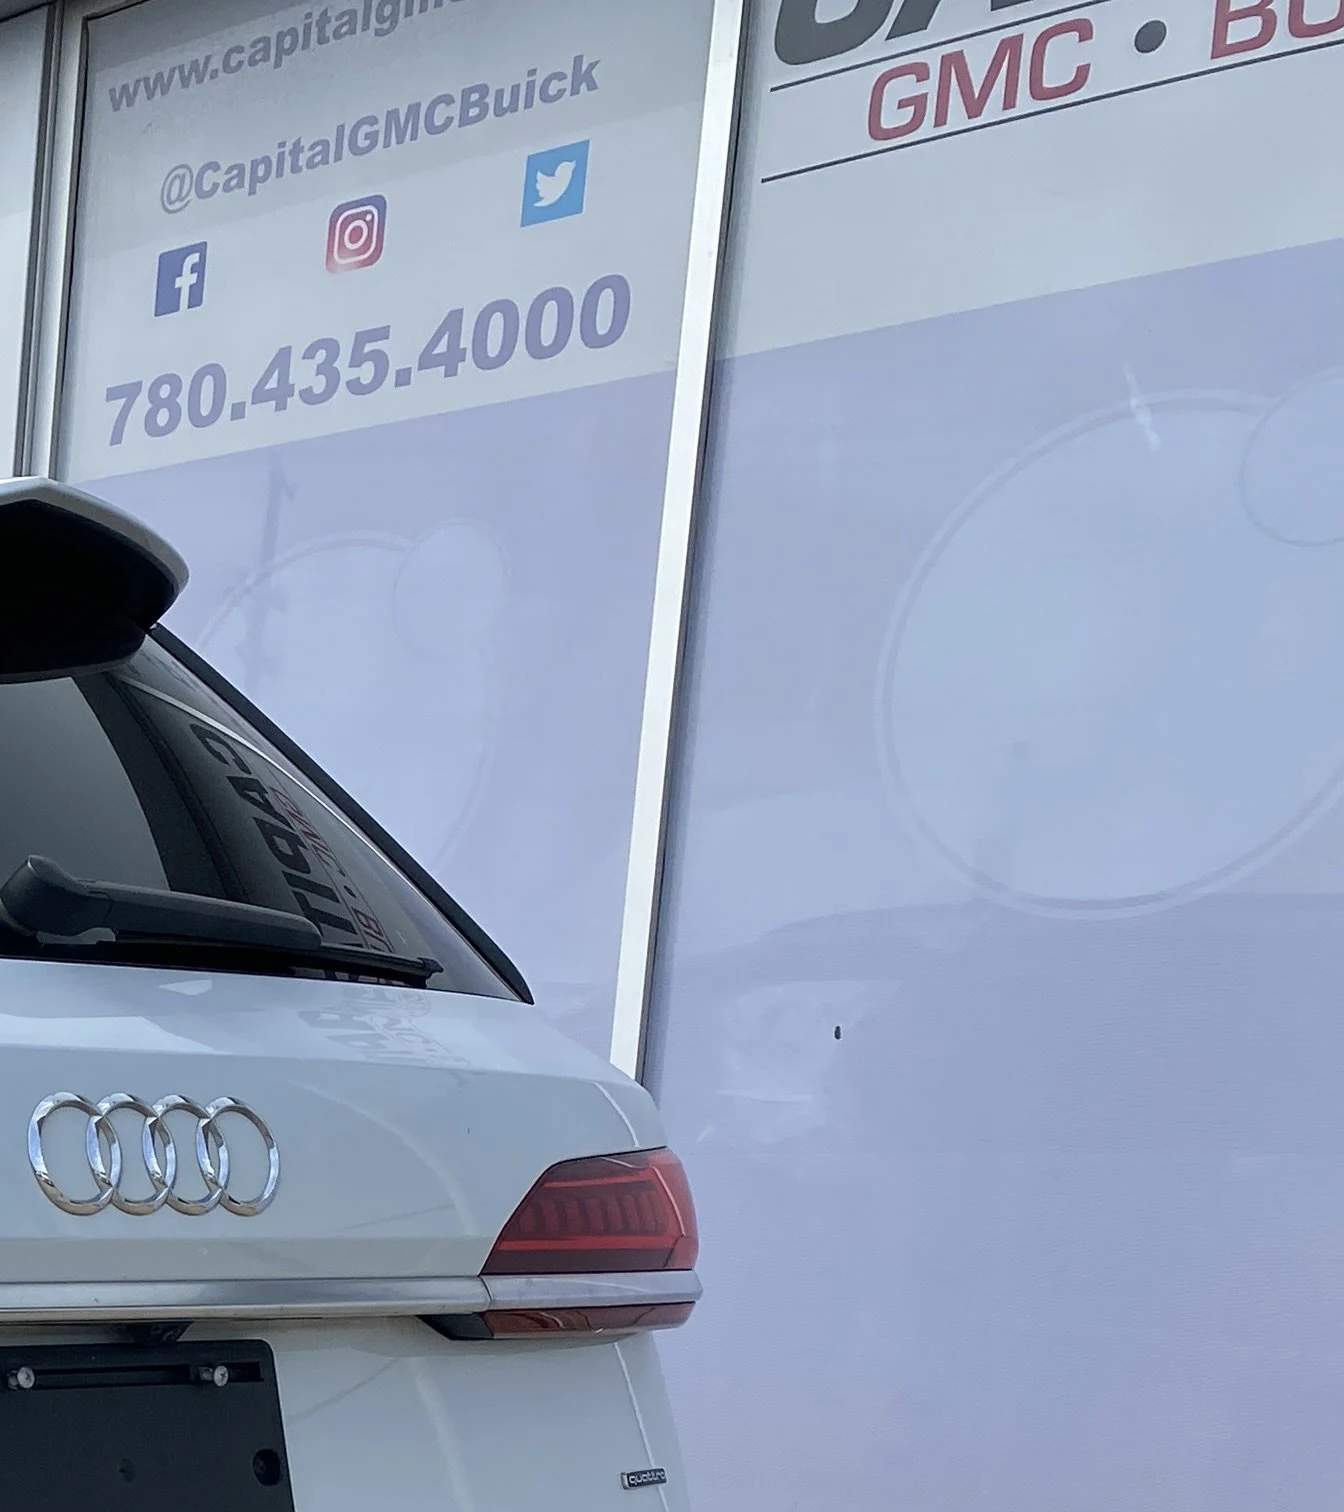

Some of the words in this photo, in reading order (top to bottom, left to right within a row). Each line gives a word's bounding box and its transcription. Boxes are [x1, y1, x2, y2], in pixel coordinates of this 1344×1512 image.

[108, 0, 462, 113] www.capitalg
[868, 18, 1094, 141] GMC
[160, 54, 601, 213] @CapitalGMCBuick
[105, 274, 631, 446] 780.435.4000
